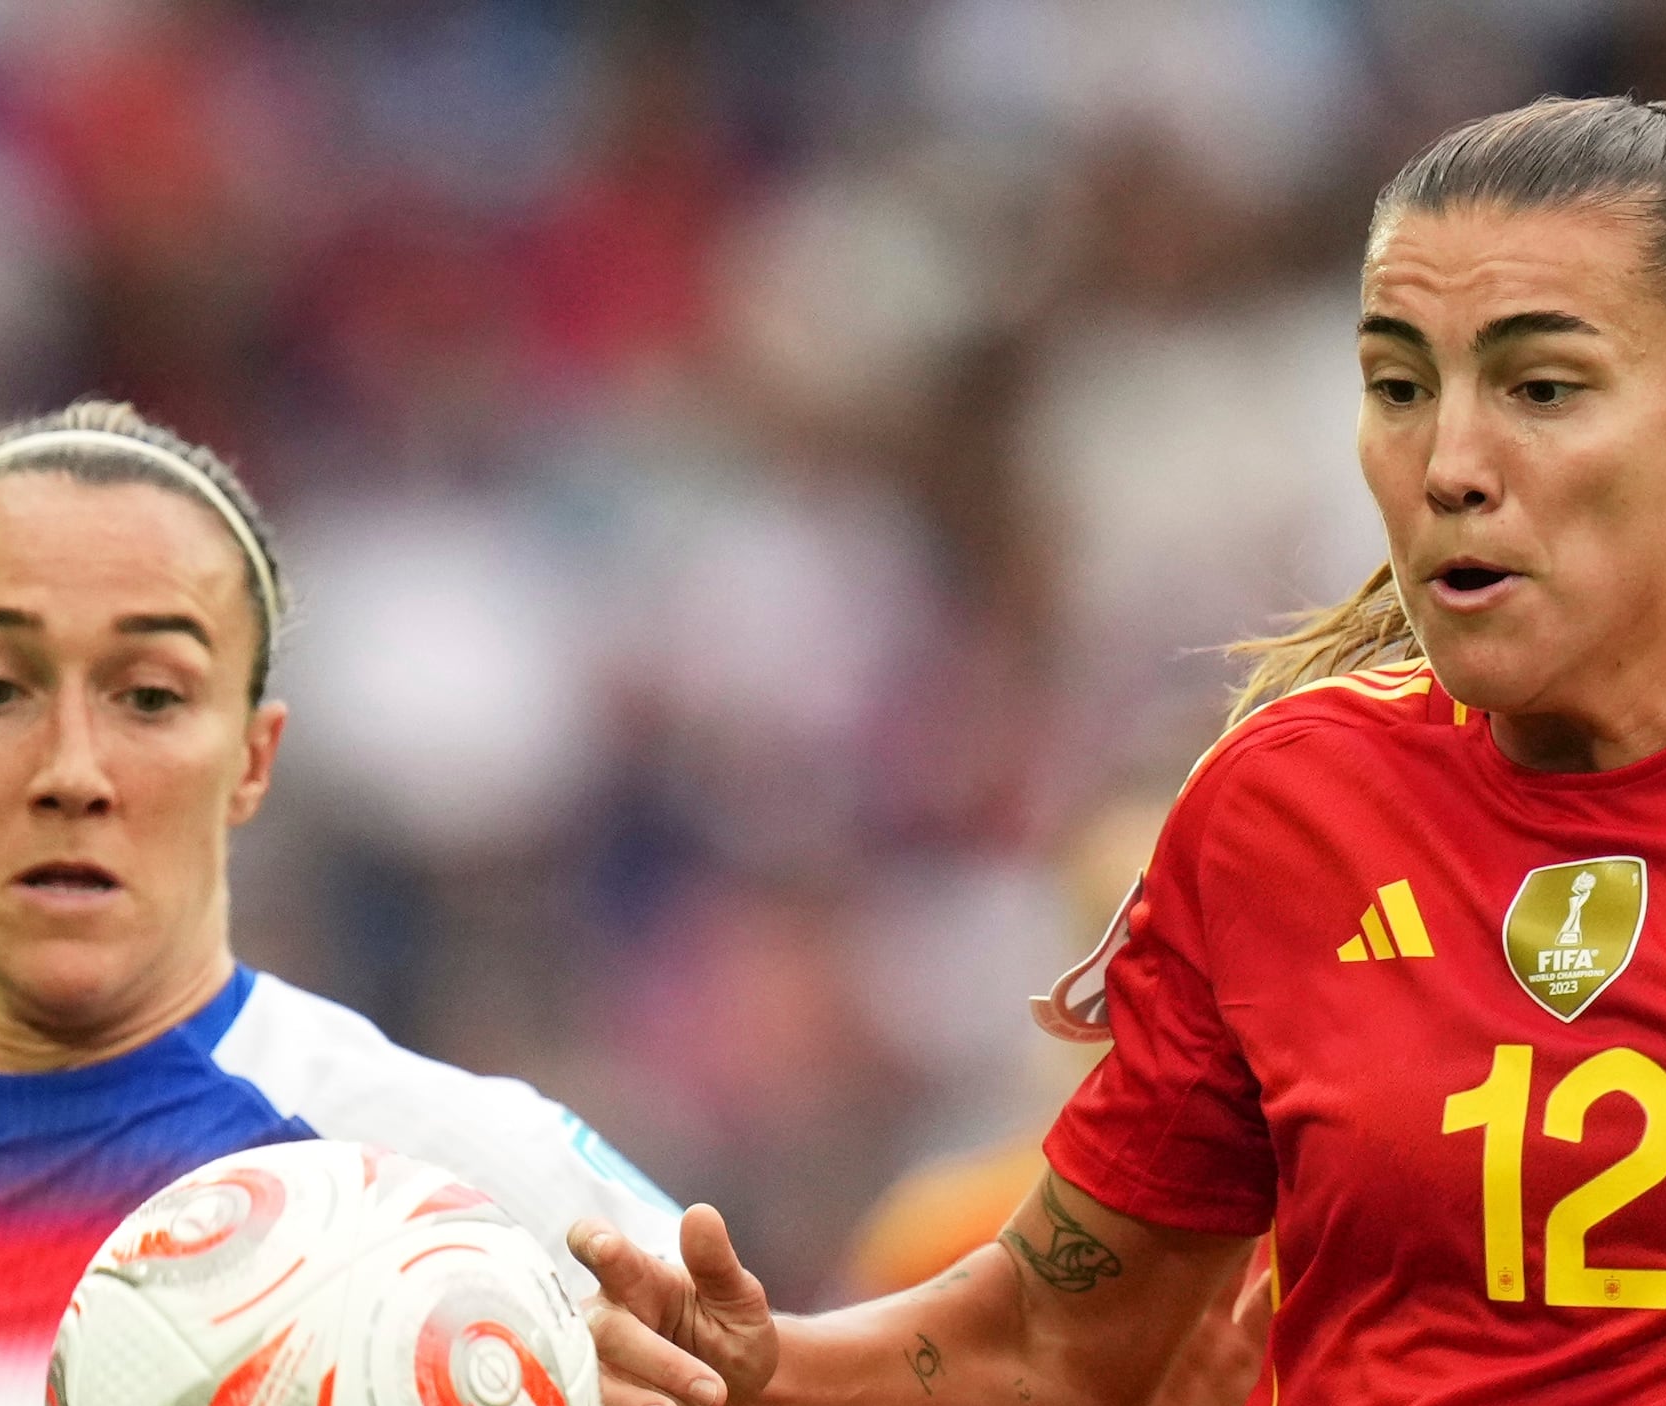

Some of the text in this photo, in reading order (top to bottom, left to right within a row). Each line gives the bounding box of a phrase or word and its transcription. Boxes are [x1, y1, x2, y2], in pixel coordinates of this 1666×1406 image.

[1538, 949, 1593, 972] FIFA
[1528, 969, 1606, 983] WORLD CHAMPIONS
[1548, 981, 1579, 995] 2023
